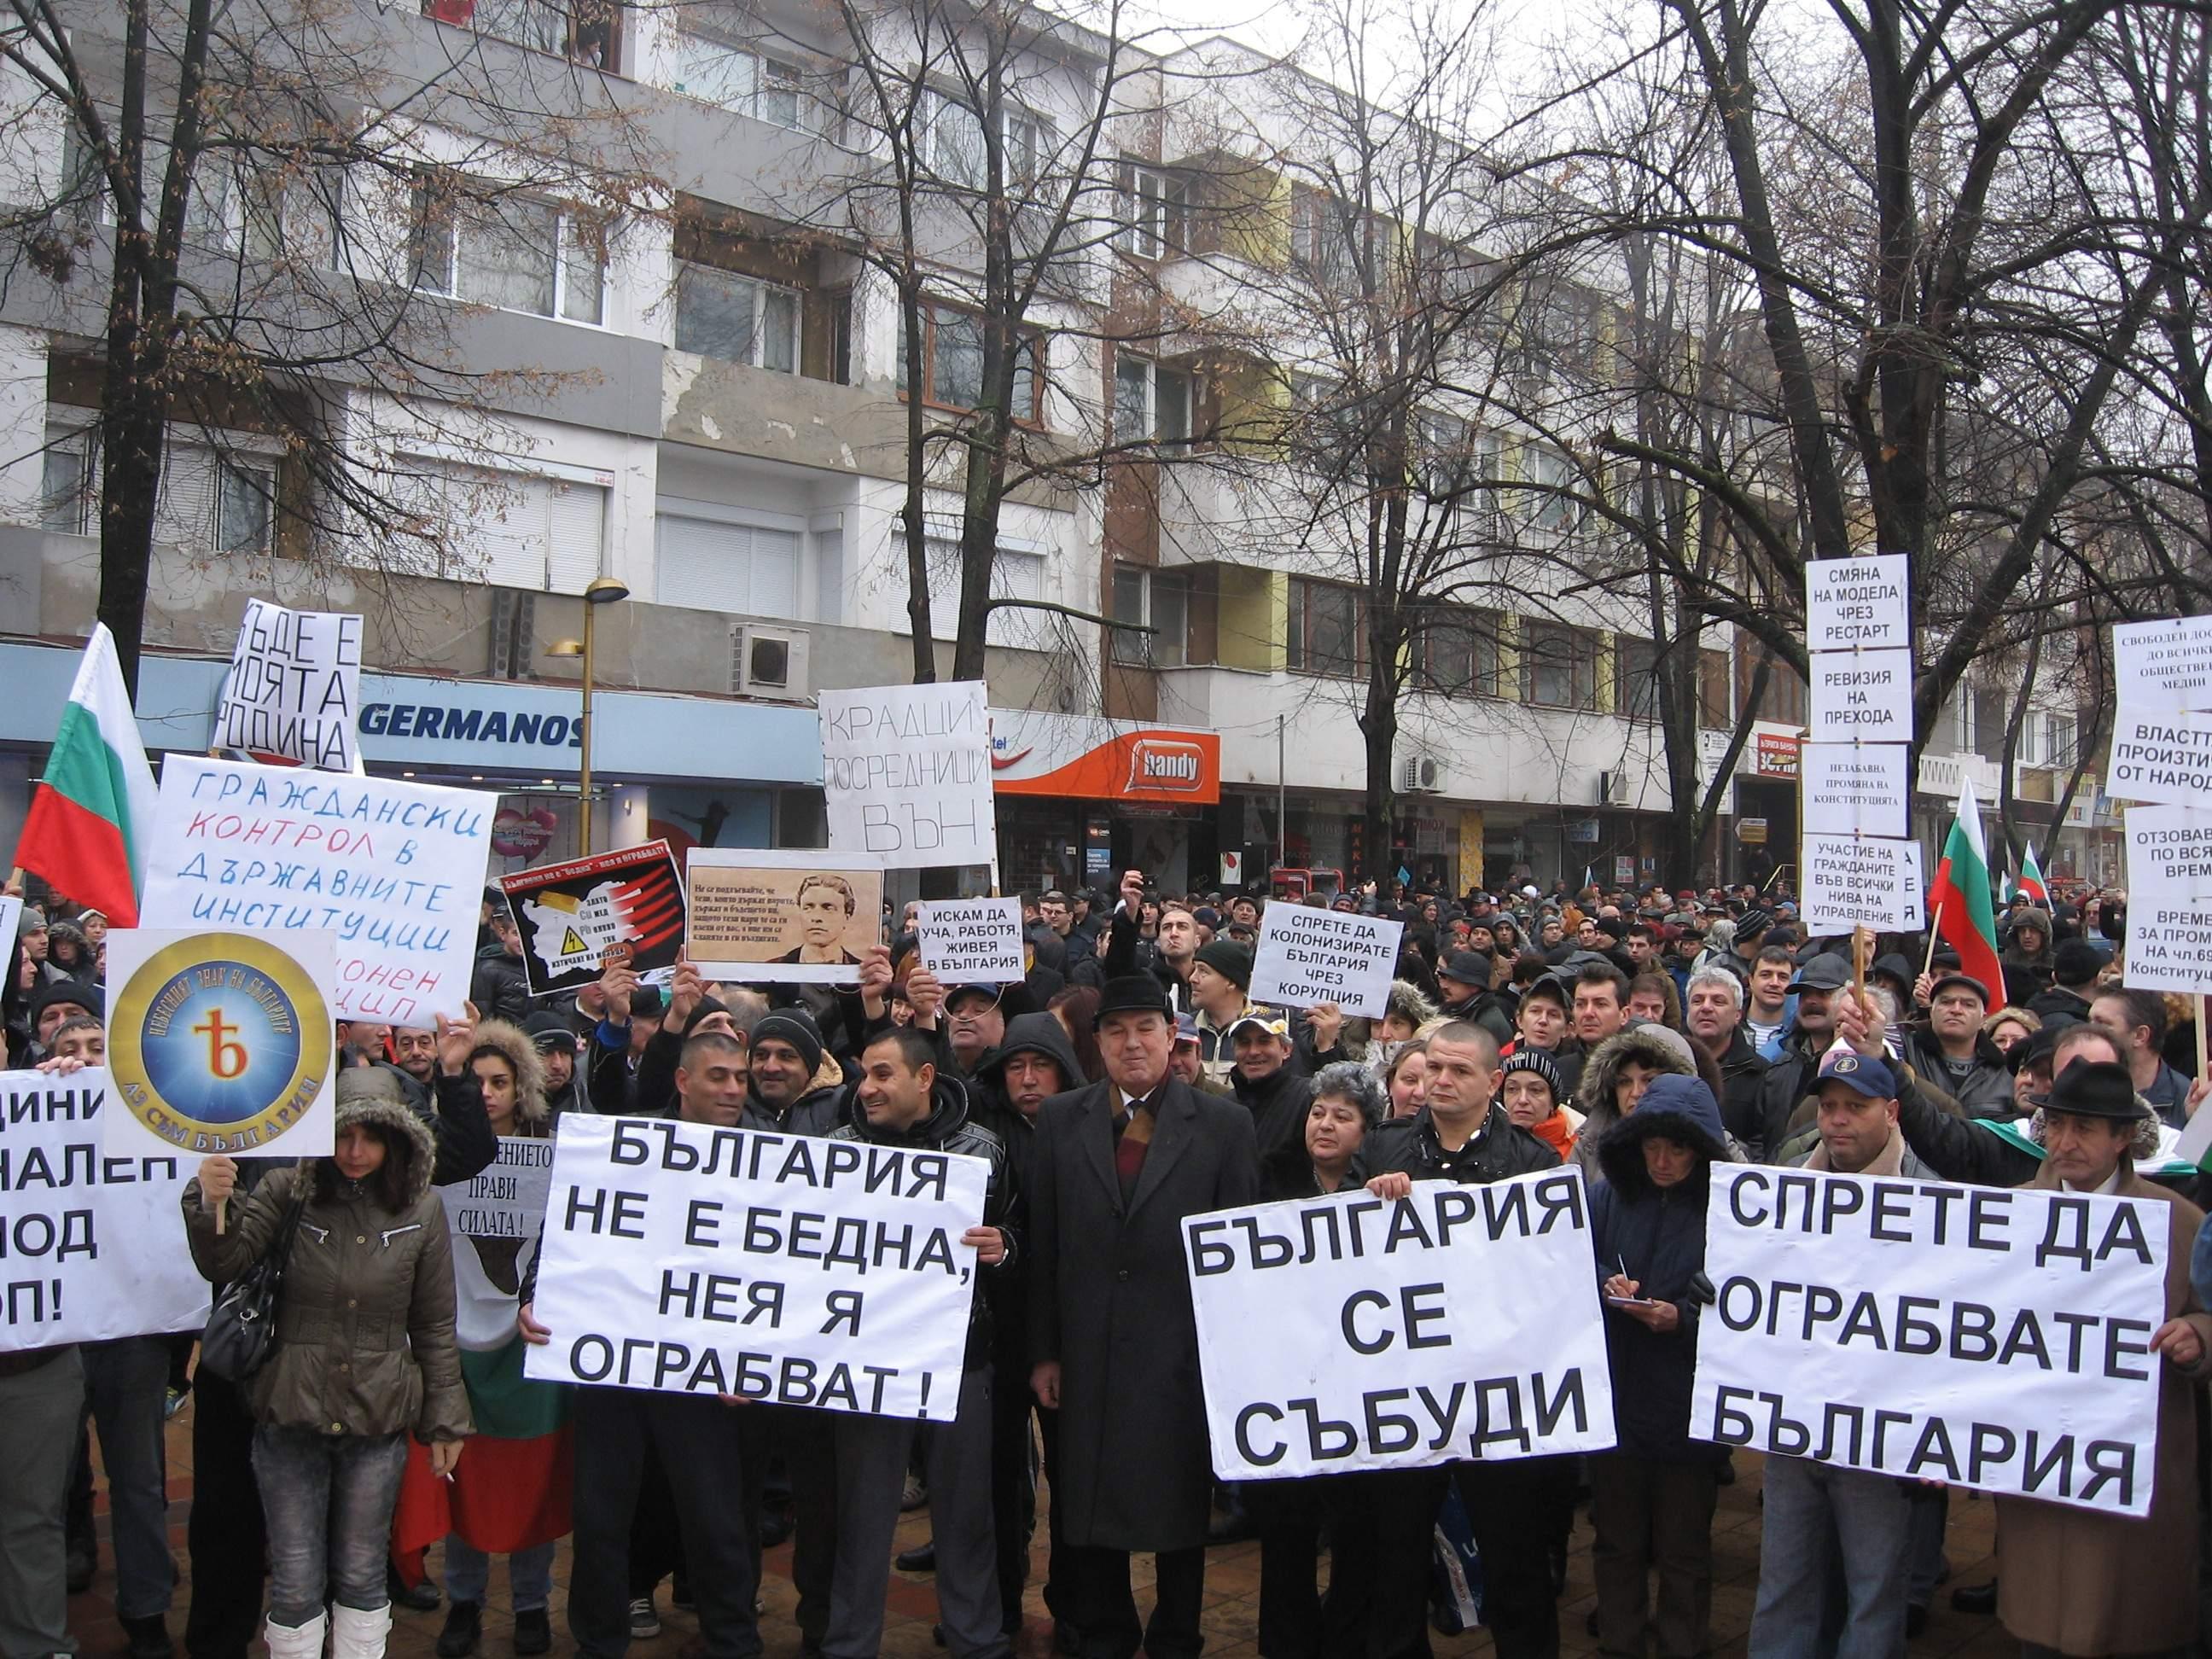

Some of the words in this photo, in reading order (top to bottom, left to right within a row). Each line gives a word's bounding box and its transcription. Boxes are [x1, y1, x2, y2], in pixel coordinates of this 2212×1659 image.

[1829, 567, 1881, 584] СМЯНА
[1814, 589, 1832, 602] НА
[1837, 585, 1899, 602] МОДЕЛА
[1837, 606, 1873, 620] ЧРЕЗ
[337, 617, 359, 667] Е
[1825, 624, 1890, 640] РЕСТАРТ
[2122, 632, 2187, 647] СВОБОДЕН
[2146, 650, 2164, 662] ДО
[1825, 671, 1892, 686] РЕВИЗИЯ
[2162, 678, 2206, 690] МЕДИИ
[1848, 691, 1867, 704] НА
[358, 702, 584, 748] GERMANOS
[828, 700, 974, 740] КРАДЦИ
[1825, 709, 1894, 725] ПРЕХОДА
[2135, 725, 2212, 747] ВЛАСТТ
[1144, 750, 1198, 781] handy
[2117, 742, 2212, 768] ПРОИЗТИ
[824, 749, 989, 790] ПОСРЕДНИЦИ
[1830, 764, 1885, 773] НЕЗАБАВНА
[2116, 765, 2145, 781] ОТ
[1826, 780, 1874, 789] ПРОМЯНА
[191, 772, 482, 837] ГРАЖДАНСКИ
[1814, 795, 1898, 806] КОНСТИТУЦИЯТА
[185, 810, 374, 859] КОНТРОЛ
[862, 799, 977, 853] ВЪН
[1818, 842, 1875, 858] УЧАСТИЕ
[1878, 848, 1894, 860] НА
[2151, 848, 2174, 861] ПО
[1813, 859, 1895, 876] ГРАЖДАНИТЕ
[177, 852, 454, 912] ДЪРЖАВНИТЕ
[1815, 874, 1843, 886] ВЪВ
[1847, 876, 1894, 892] ВСИЧКИ
[1828, 891, 1863, 904] НИВА
[1866, 895, 1883, 906] НА
[192, 893, 451, 952] ИНСТИТУЦИИ
[932, 910, 983, 923] ИСКАМ
[987, 908, 1007, 923] ДА
[1813, 905, 1894, 924] УПРАВЛЕНИЕ
[922, 927, 955, 940] УЧА,
[958, 923, 1021, 938] РАБОТЯ,
[1291, 915, 1351, 935] СПРЕТЕ
[1353, 925, 1377, 940] ДА
[2138, 927, 2158, 940] ЗА
[945, 941, 998, 954] ЖИВЕЯ
[1270, 928, 1391, 958] КОЛОНИЗИРАТЕ
[2145, 945, 2168, 958] НА
[928, 960, 938, 971] В
[941, 956, 1019, 971] БЪЛГАРИЯ
[1286, 948, 1369, 972] БЪЛГАРИЯ
[229, 969, 247, 990] НА
[1306, 969, 1344, 986] ЧРЕЗ
[1278, 981, 1364, 1006] КОРУПЦИЯ
[123, 1082, 148, 1106] АЗ
[146, 1108, 189, 1143] СЪМ
[497, 1142, 553, 1167] ЕНИЕТО
[610, 1121, 949, 1202] БЪЛГАРИЯ
[469, 1175, 517, 1200] ПРАВИ
[1189, 1174, 1586, 1277] БЪЛГАРИЯ
[1730, 1171, 2012, 1252] СПРЕТЕ
[2034, 1196, 2154, 1272] ДА
[564, 1185, 649, 1240] НЕ
[685, 1200, 724, 1249] Е
[743, 1207, 970, 1285] БЕДНА,
[658, 1269, 785, 1329] НЕЯ
[819, 1289, 864, 1337] Я
[1341, 1282, 1452, 1355] СЕ
[1719, 1275, 2152, 1382] ОГРАБВАТЕ
[1235, 1367, 1588, 1468] СЪБУДИ
[1712, 1383, 2137, 1507] БЪЛГАРИЯ
